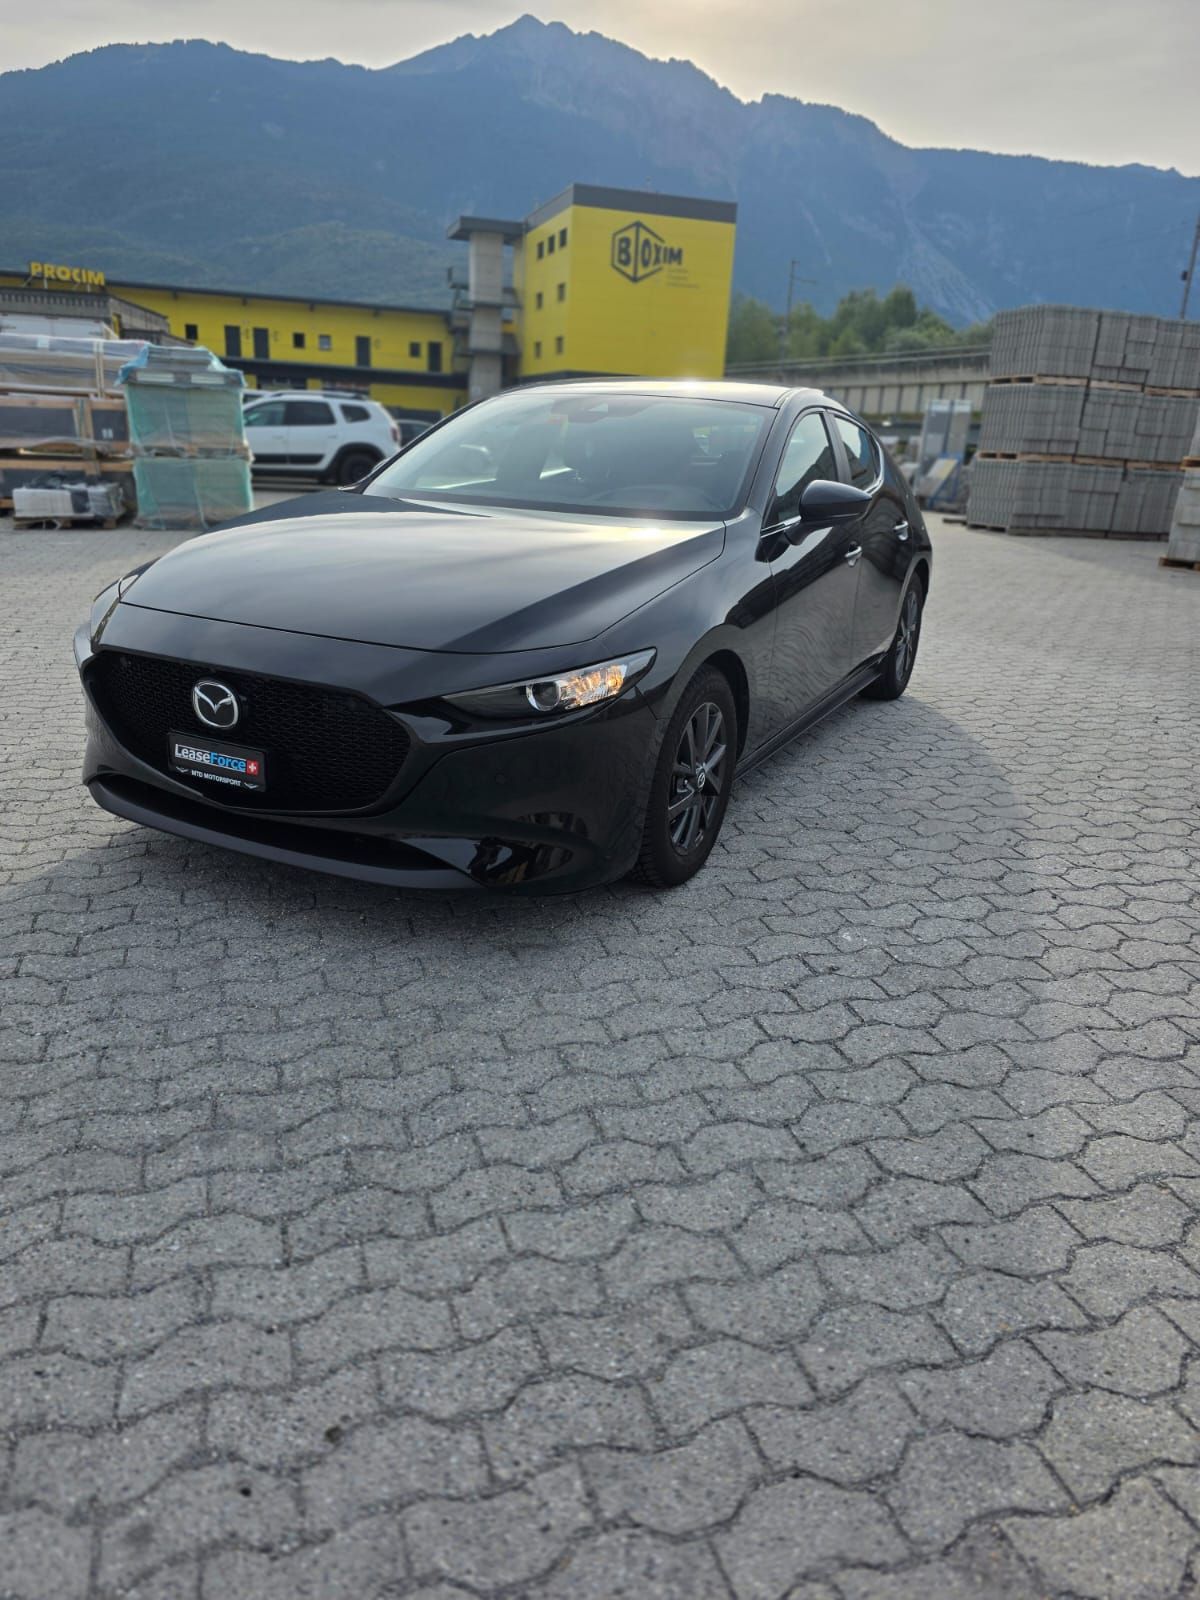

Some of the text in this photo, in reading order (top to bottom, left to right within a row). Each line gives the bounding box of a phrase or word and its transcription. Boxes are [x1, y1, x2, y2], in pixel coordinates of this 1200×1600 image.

[617, 236, 683, 268] BOXIM
[30, 262, 105, 286] PROCIM
[175, 744, 246, 771] LeaseForce
[191, 769, 241, 786] MTD MOTORSPORT
